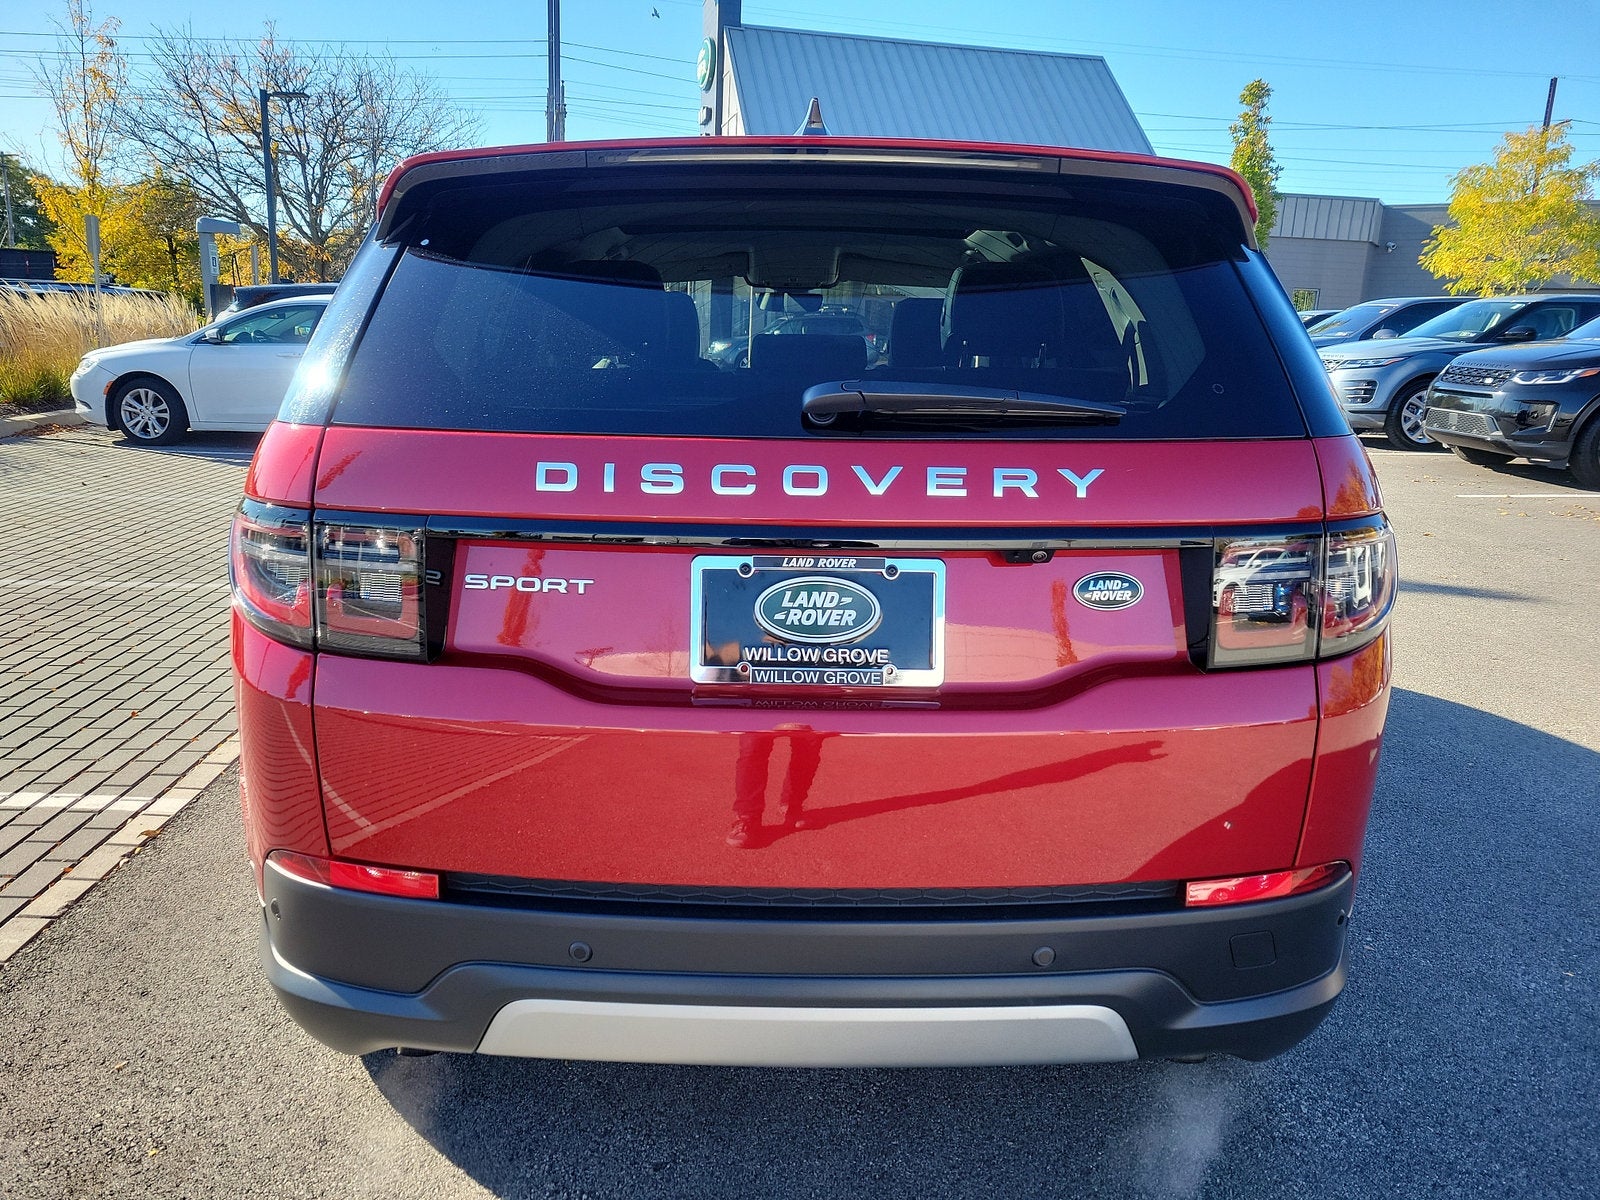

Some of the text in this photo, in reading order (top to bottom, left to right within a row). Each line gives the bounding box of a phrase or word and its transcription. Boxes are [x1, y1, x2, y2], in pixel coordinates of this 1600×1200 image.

[535, 461, 1105, 498] DISCOVERY
[782, 557, 856, 569] LAND ROVER
[464, 574, 595, 594] SPORT
[1088, 580, 1122, 591] LAND
[781, 590, 841, 608] LAND
[1091, 590, 1132, 601] ROVER
[785, 609, 857, 627] ROVER
[744, 647, 889, 663] WILLOW GROVE
[755, 670, 882, 685] WILLOW GROVE
